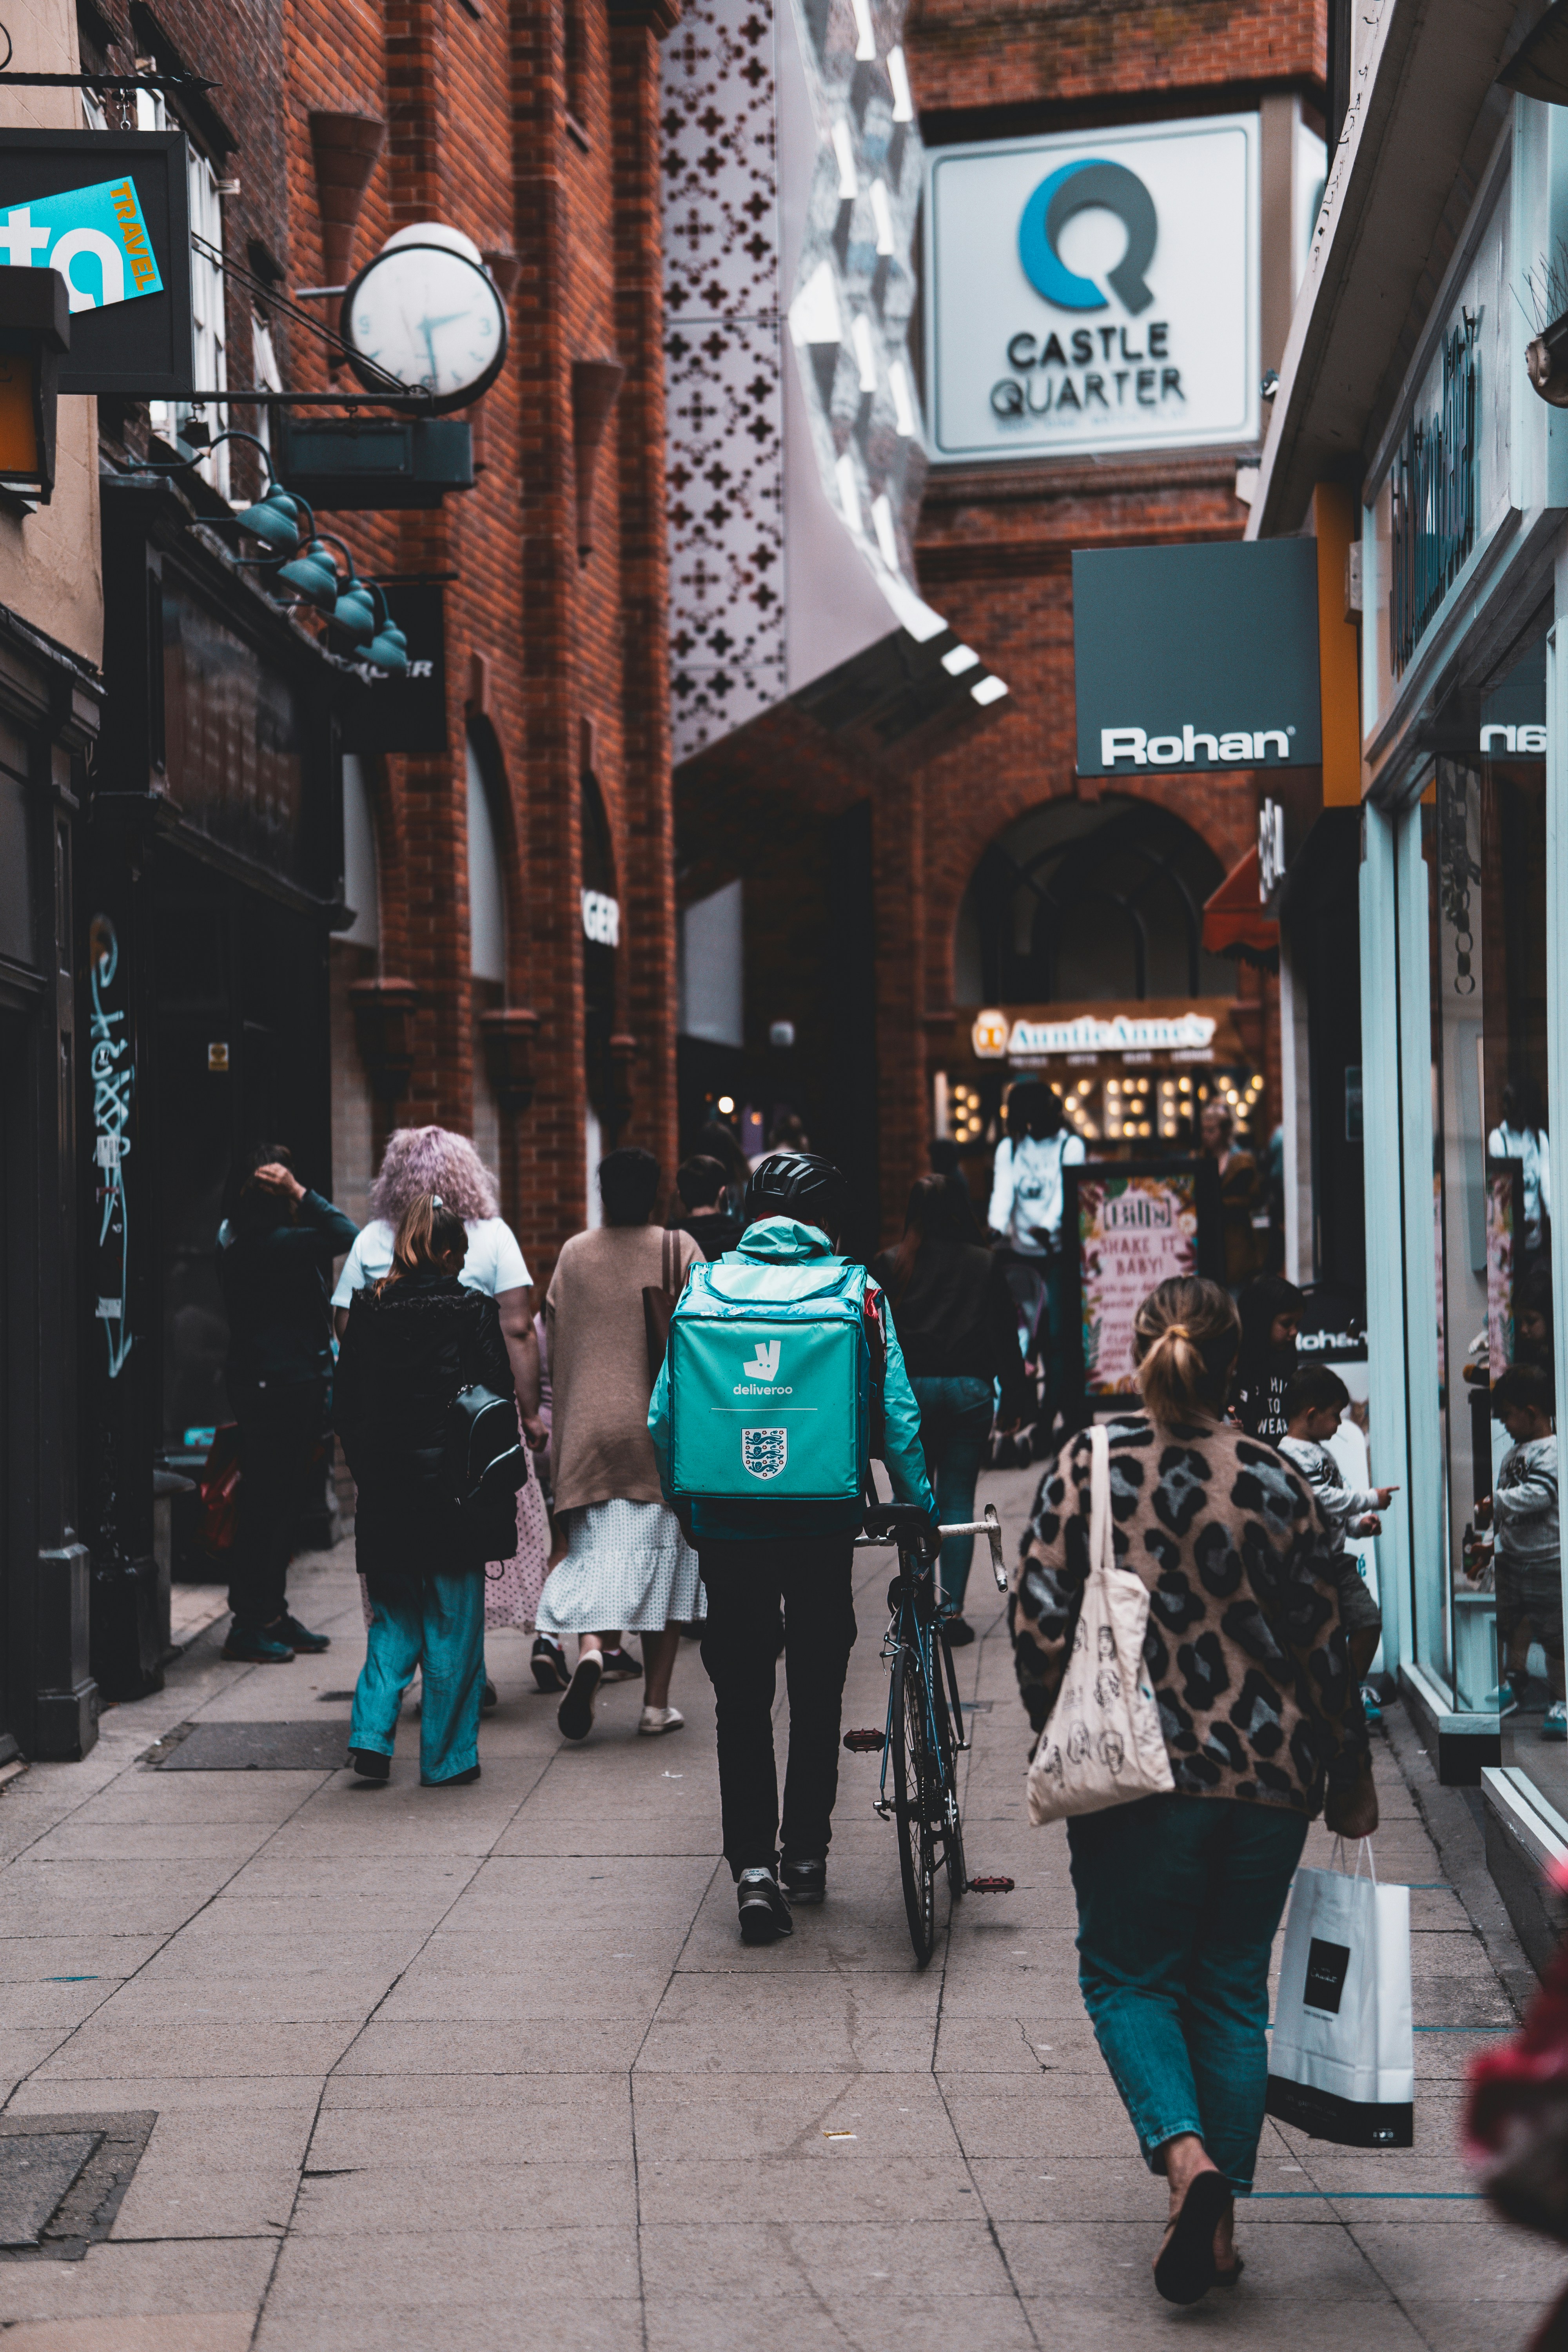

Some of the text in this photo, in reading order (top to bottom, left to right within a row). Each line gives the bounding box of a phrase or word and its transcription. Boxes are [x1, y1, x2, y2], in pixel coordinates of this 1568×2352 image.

[110, 182, 156, 291] TRAVEL
[1007, 321, 1170, 370] CASTLE
[989, 367, 1186, 418] QUARTER
[1100, 1235, 1176, 1255] SHAKE IT
[1116, 1257, 1162, 1276] BABY!
[733, 1383, 793, 1395] deliveroo
[1267, 1397, 1281, 1414] TO
